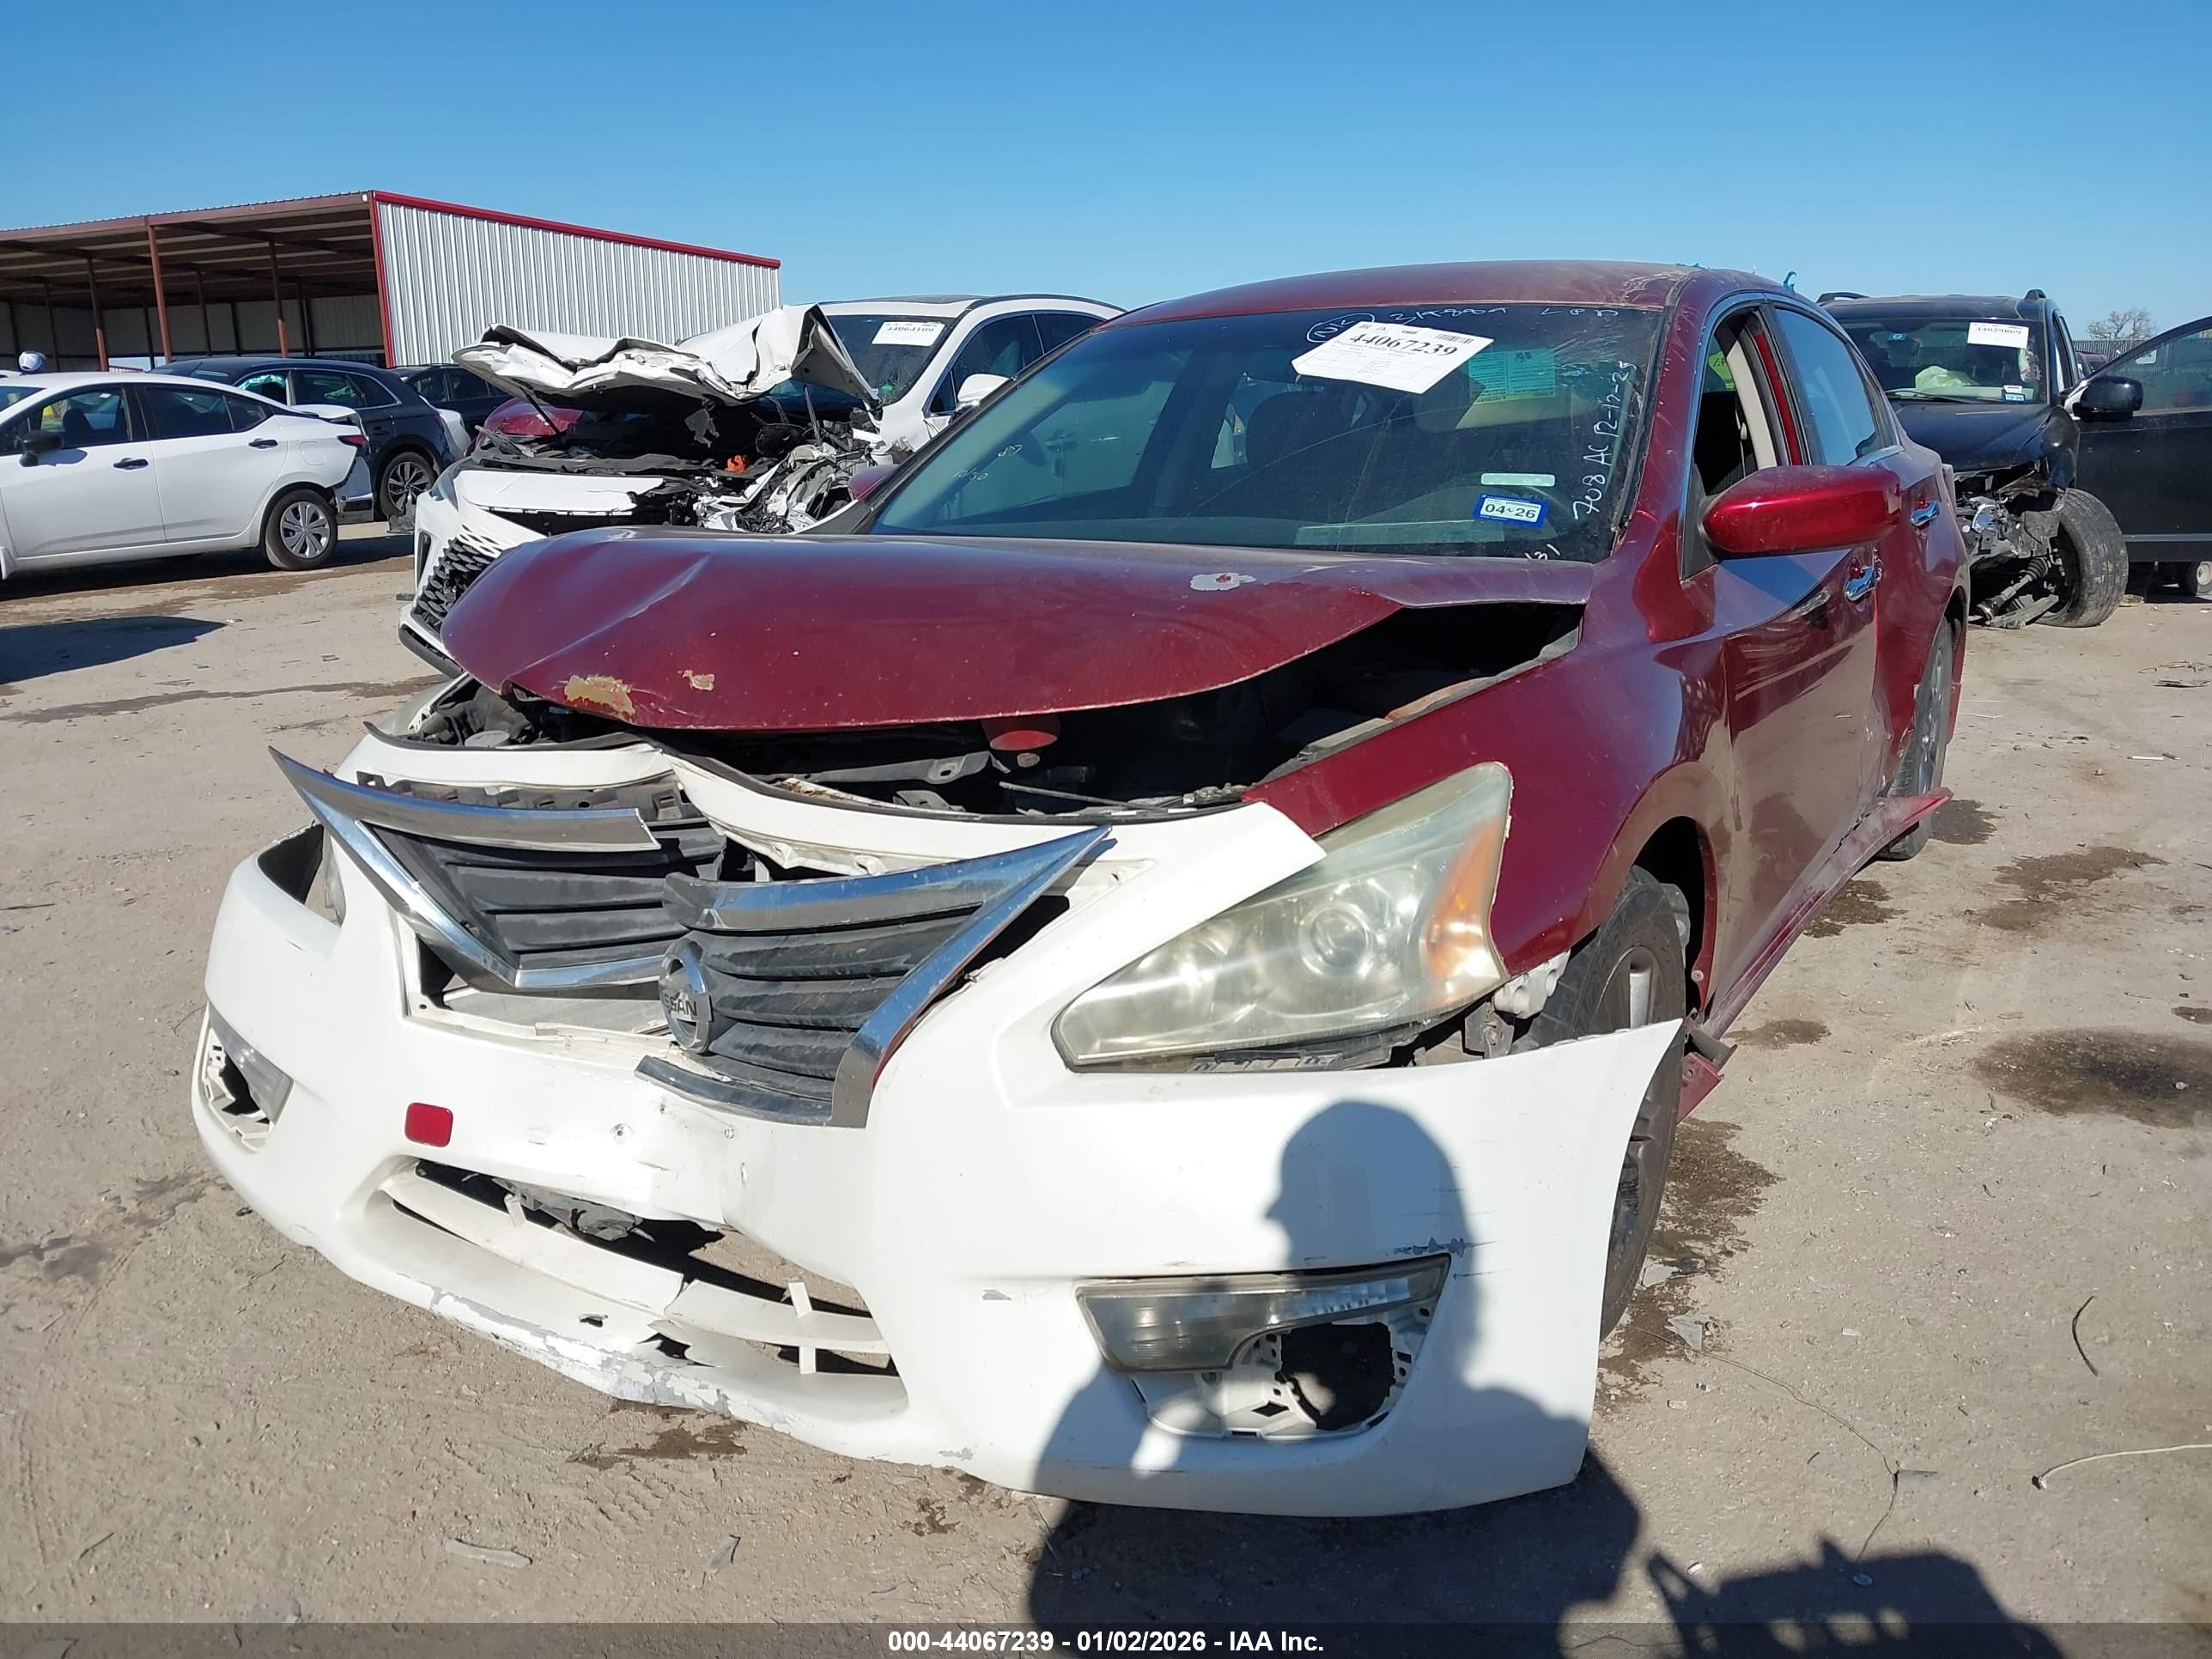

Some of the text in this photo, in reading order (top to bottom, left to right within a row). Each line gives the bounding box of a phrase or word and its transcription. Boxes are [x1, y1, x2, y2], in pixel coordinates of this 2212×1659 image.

[1349, 333, 1458, 356] 44067239
[1485, 503, 1506, 515] 04
[1514, 507, 1537, 519] 26
